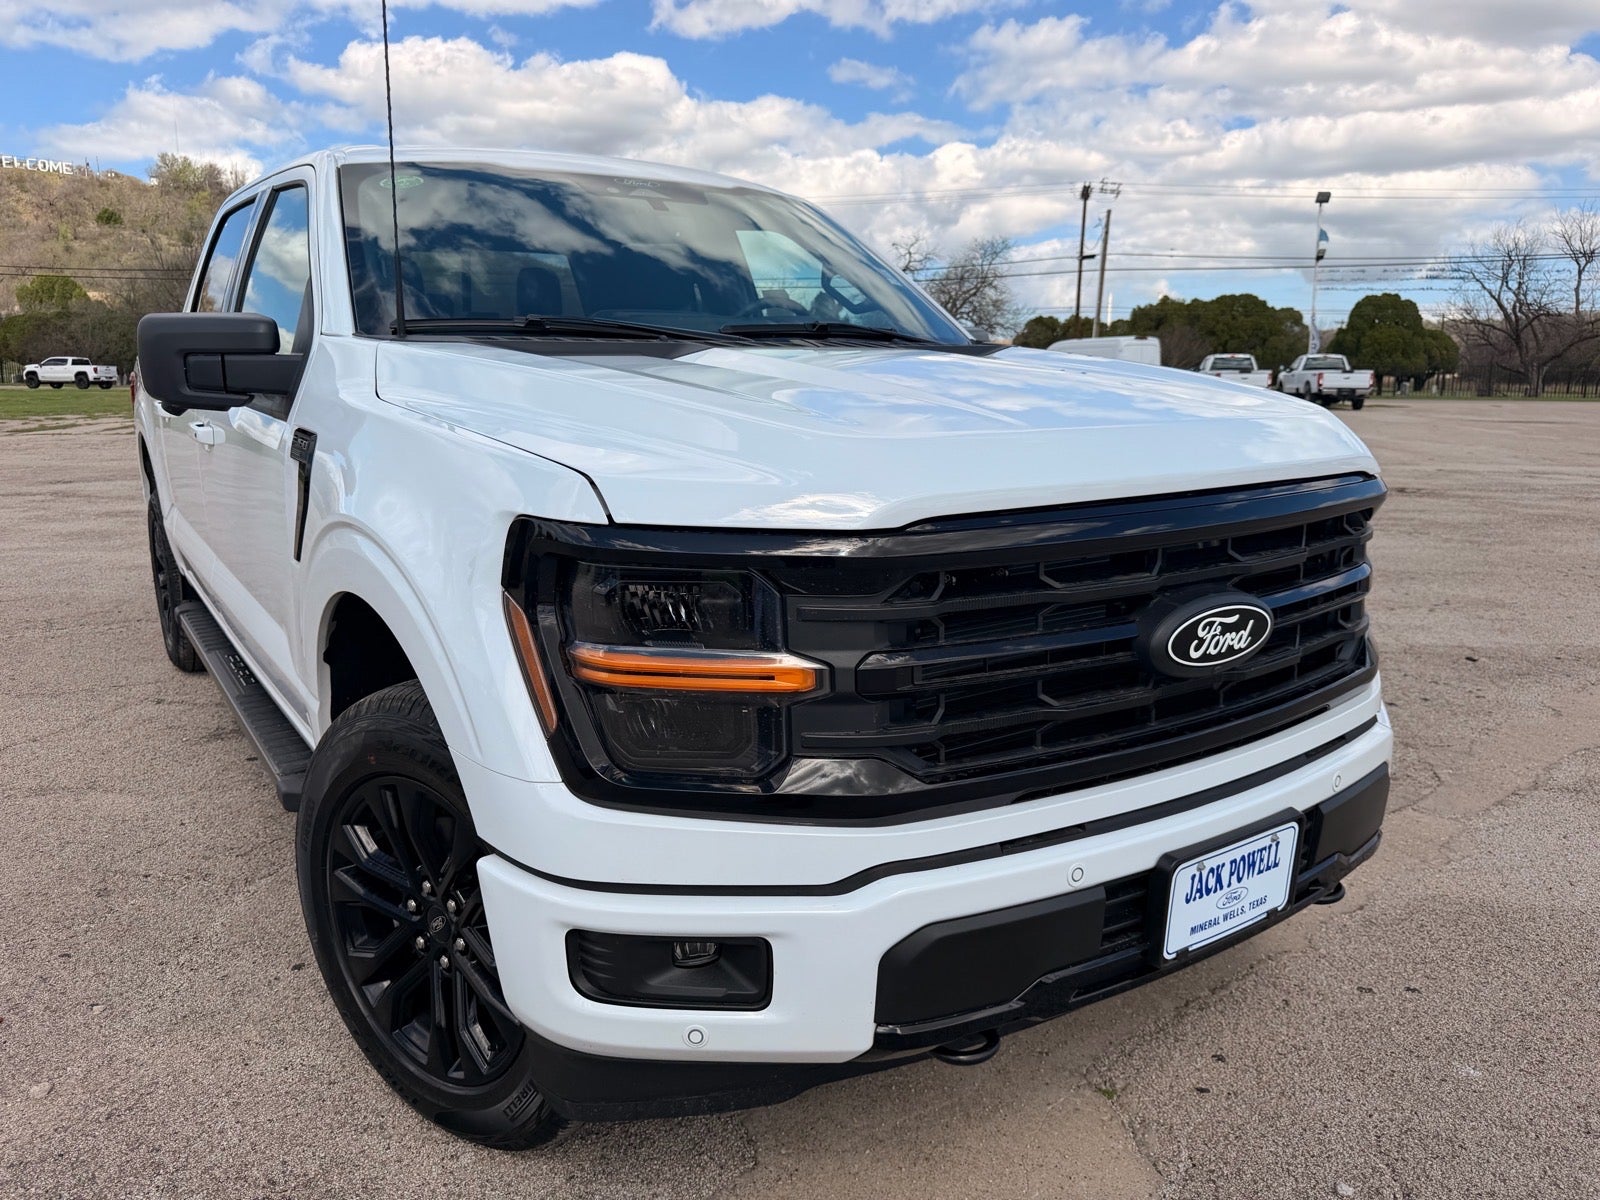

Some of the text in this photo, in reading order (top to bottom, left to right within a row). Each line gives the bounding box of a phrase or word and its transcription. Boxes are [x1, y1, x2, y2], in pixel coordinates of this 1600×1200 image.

[0, 155, 73, 175] ELCOME
[1189, 614, 1254, 659] Ford
[1185, 841, 1281, 904] JACK POWELL
[1190, 916, 1220, 936] MINERAL
[1248, 895, 1268, 911] TEXAS
[1222, 890, 1244, 907] Ford
